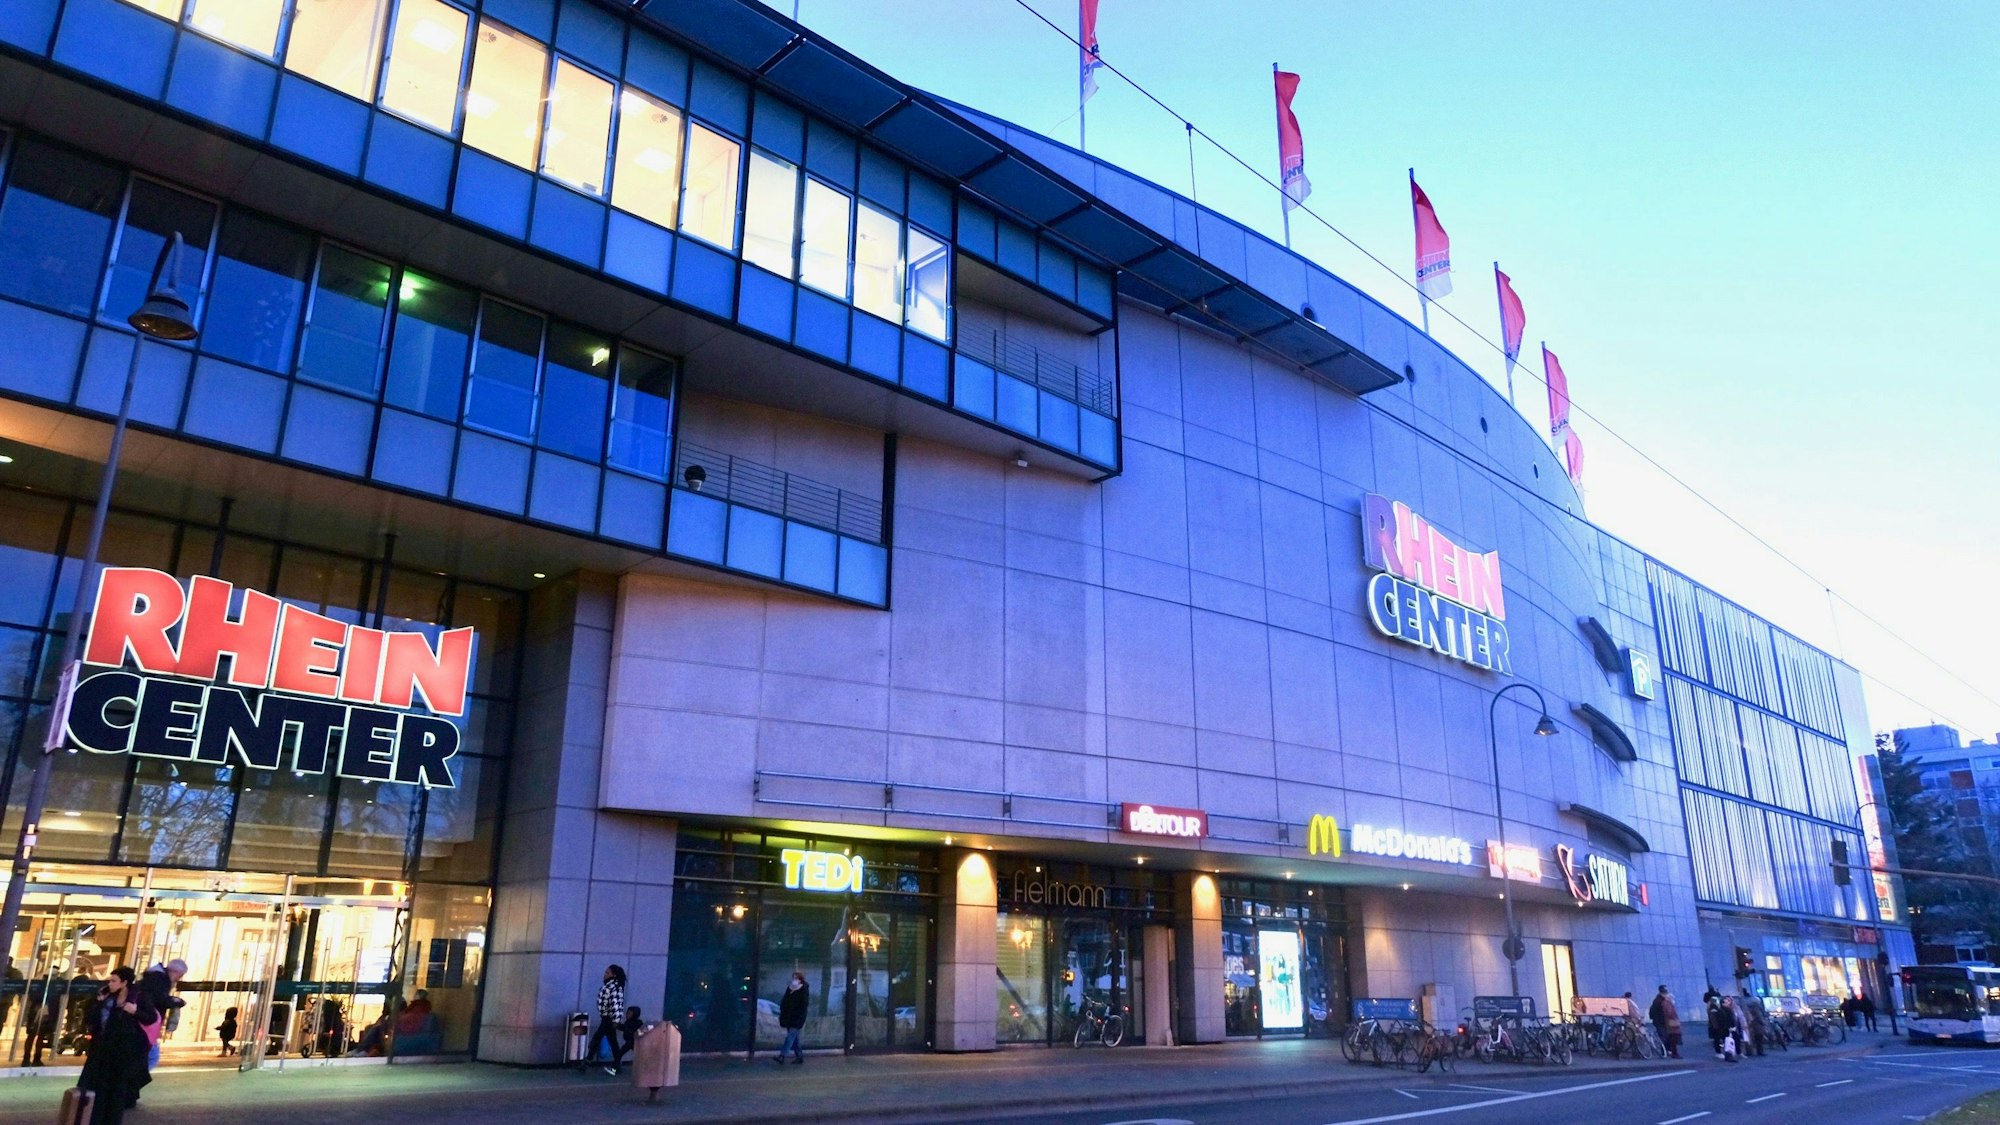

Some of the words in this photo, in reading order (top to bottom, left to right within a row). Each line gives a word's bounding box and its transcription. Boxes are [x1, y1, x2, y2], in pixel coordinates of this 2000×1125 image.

[1361, 492, 1506, 621] RHEIN
[85, 567, 474, 715] RHEIN
[1366, 572, 1513, 676] CENTER
[1638, 667, 1647, 693] P
[66, 672, 461, 788] CENTER
[1130, 808, 1201, 836] DERTOUR
[1351, 824, 1473, 865] McDonald's
[1014, 869, 1107, 909] fielmann
[1588, 853, 1629, 906] SATURN
